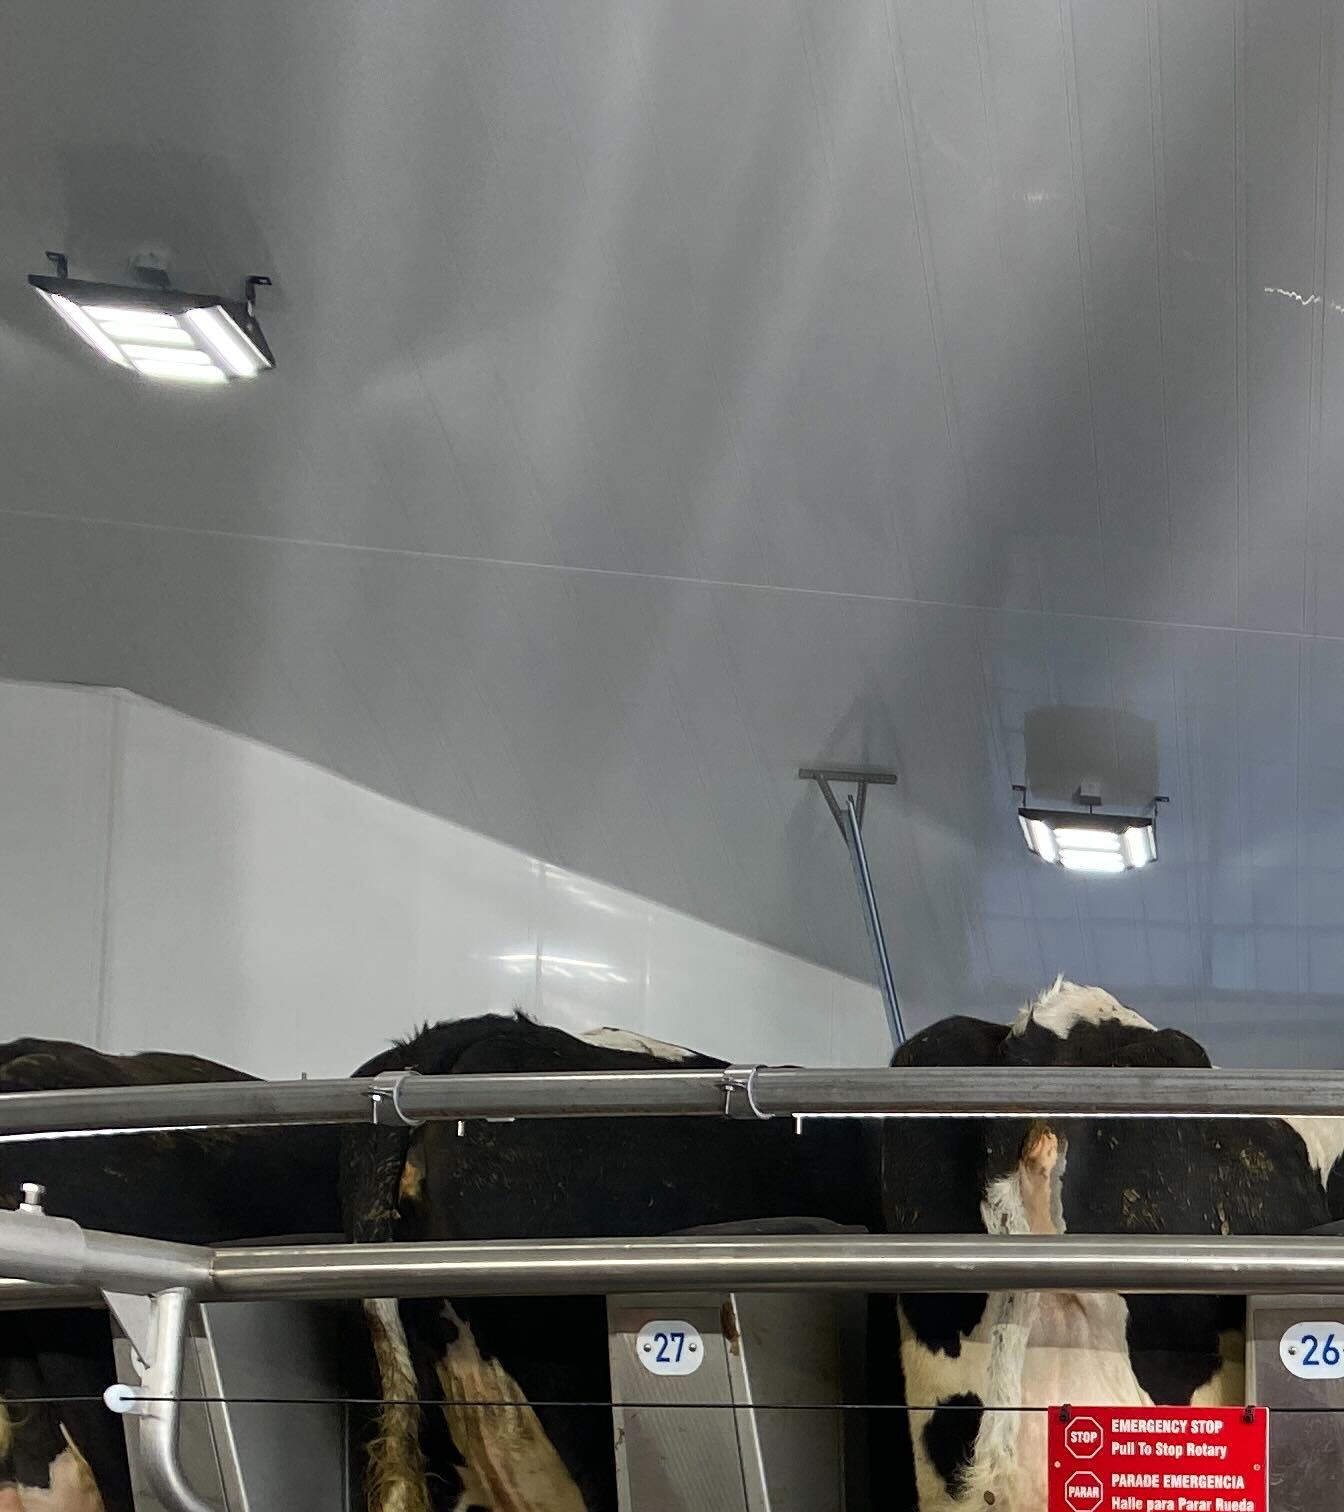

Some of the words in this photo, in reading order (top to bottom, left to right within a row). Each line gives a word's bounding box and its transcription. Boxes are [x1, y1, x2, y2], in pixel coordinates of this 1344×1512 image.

[655, 1332, 685, 1363] 27
[1301, 1333, 1341, 1366] 26
[1111, 1418, 1188, 1434] EMERGENCY
[1190, 1419, 1224, 1434] STOP
[1070, 1431, 1098, 1444] STOP
[1111, 1442, 1135, 1456] Pull
[1137, 1442, 1153, 1456] To
[1155, 1443, 1184, 1459] Stop
[1186, 1443, 1228, 1459] Rotary
[1111, 1473, 1160, 1488] PARADE
[1163, 1474, 1245, 1490] EMERGENCIA
[1068, 1486, 1100, 1499] PARAR
[1146, 1499, 1175, 1512] para
[1177, 1497, 1213, 1512] Parar
[1215, 1498, 1255, 1512] Rueda
